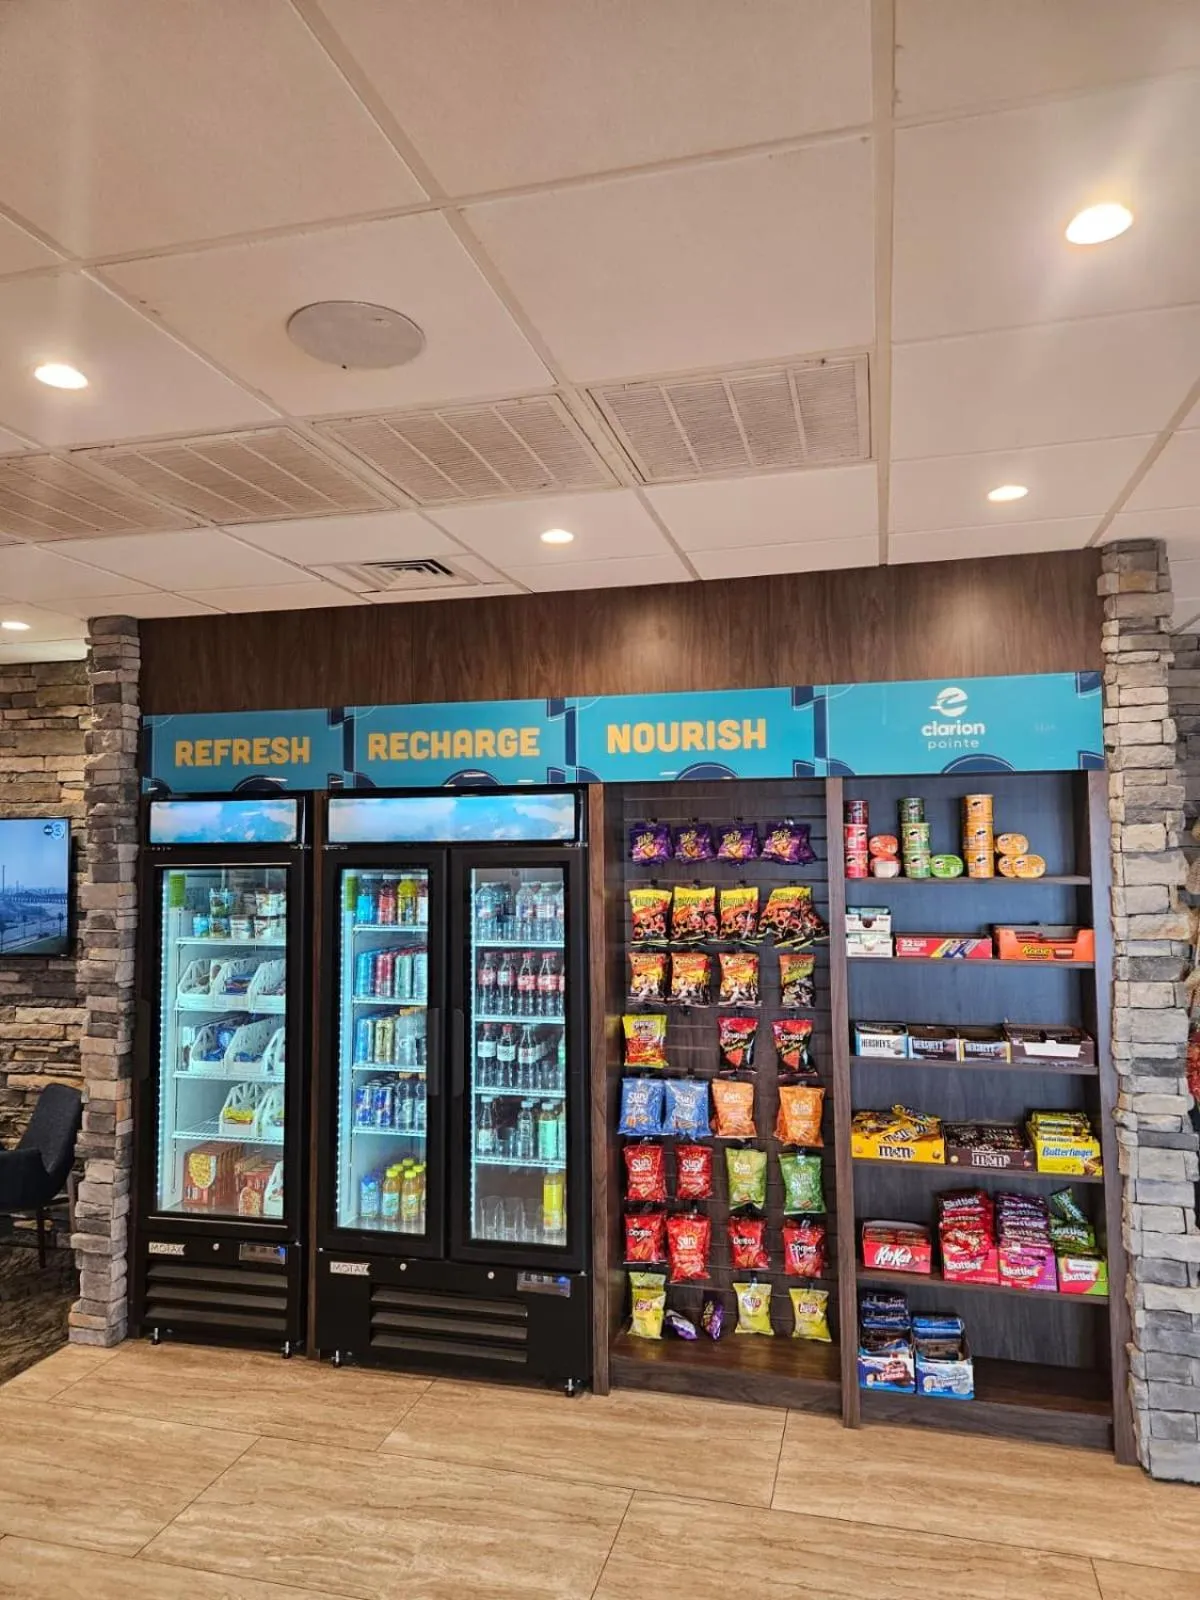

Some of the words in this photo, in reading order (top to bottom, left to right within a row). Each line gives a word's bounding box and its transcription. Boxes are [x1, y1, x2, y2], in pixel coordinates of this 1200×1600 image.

[921, 720, 986, 736] clarion
[606, 718, 767, 754] NOURISH
[175, 736, 310, 767] REFRESH
[368, 727, 540, 761] RECHARGE
[927, 738, 980, 751] pointe
[861, 1039, 891, 1048] HERSHEY'S
[1043, 1146, 1093, 1160] Butterfinger
[677, 1235, 698, 1250] Sun
